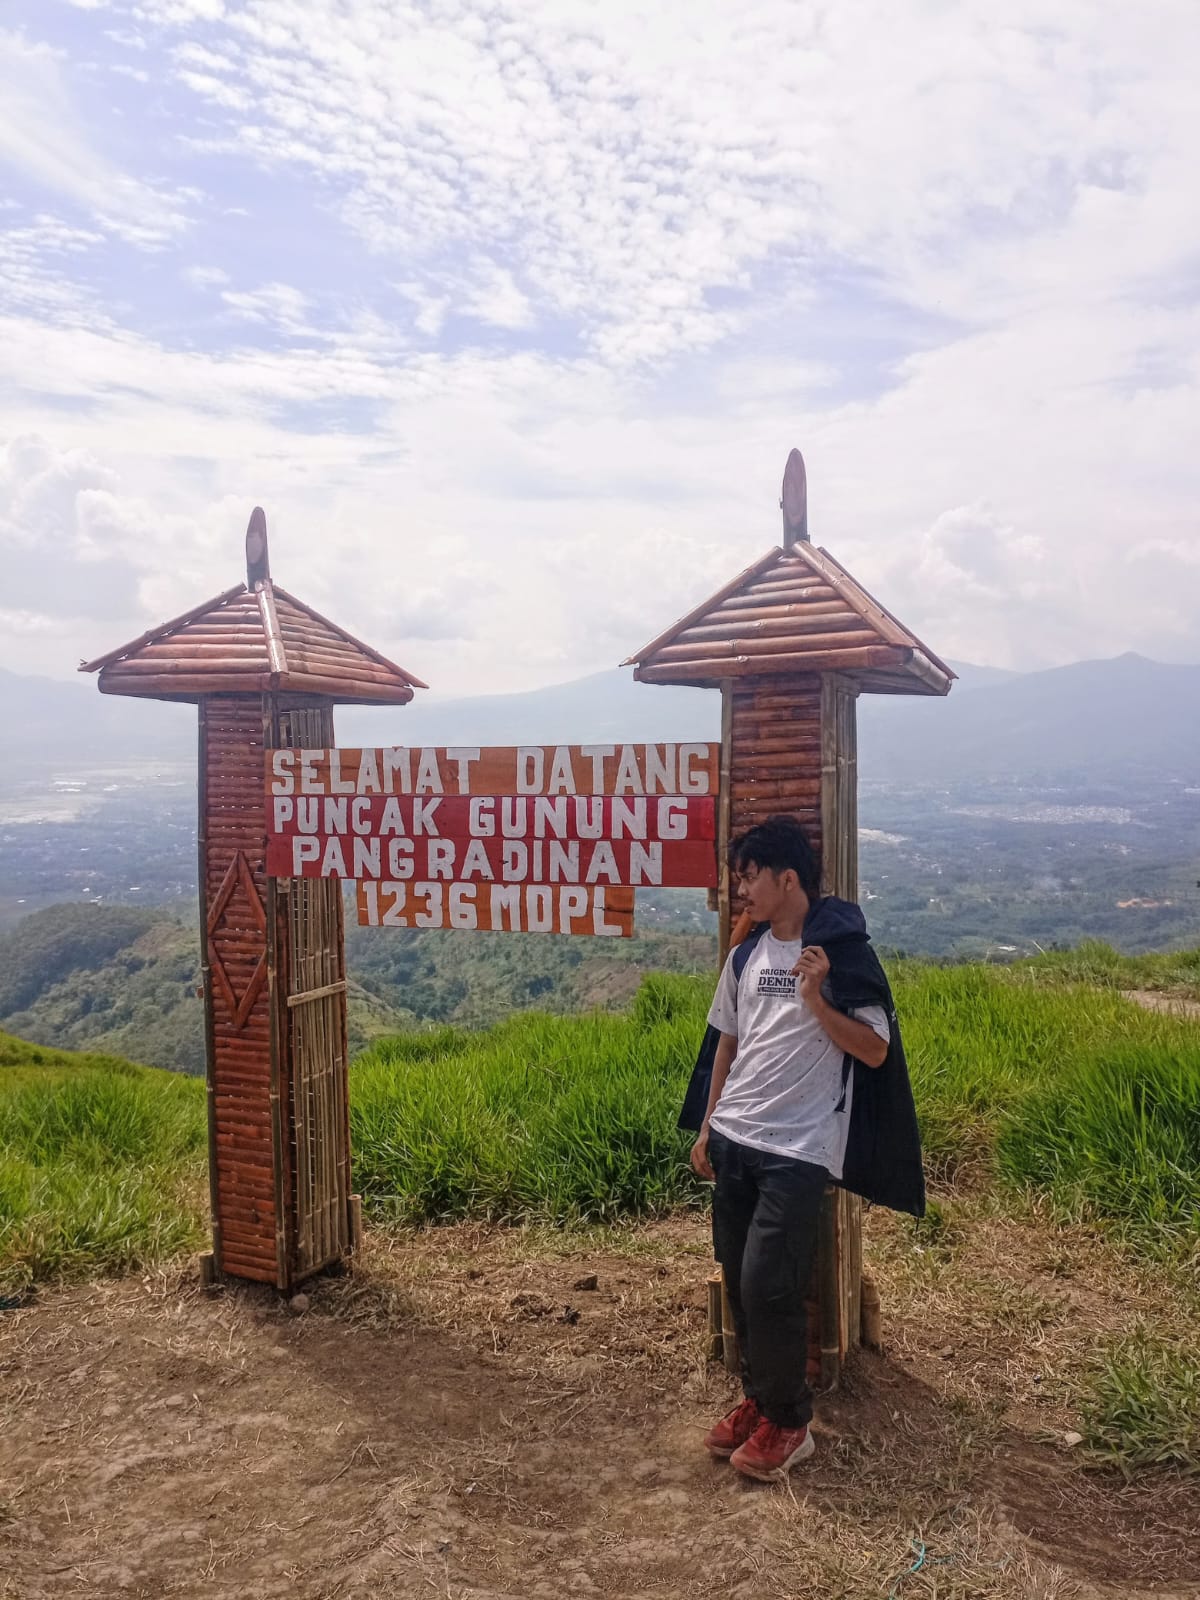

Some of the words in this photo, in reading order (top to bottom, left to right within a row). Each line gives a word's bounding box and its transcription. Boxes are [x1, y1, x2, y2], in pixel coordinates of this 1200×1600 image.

[272, 748, 480, 795] SELAMAT
[516, 743, 709, 795] DATANG
[273, 796, 443, 836] PUNCAK
[469, 796, 688, 839] GUNUNG
[292, 836, 662, 885] PANGRADINAN
[362, 880, 478, 930] 1236
[490, 884, 623, 937] MDPL
[758, 976, 796, 987] DENIM
[760, 968, 793, 976] ORIGINA
